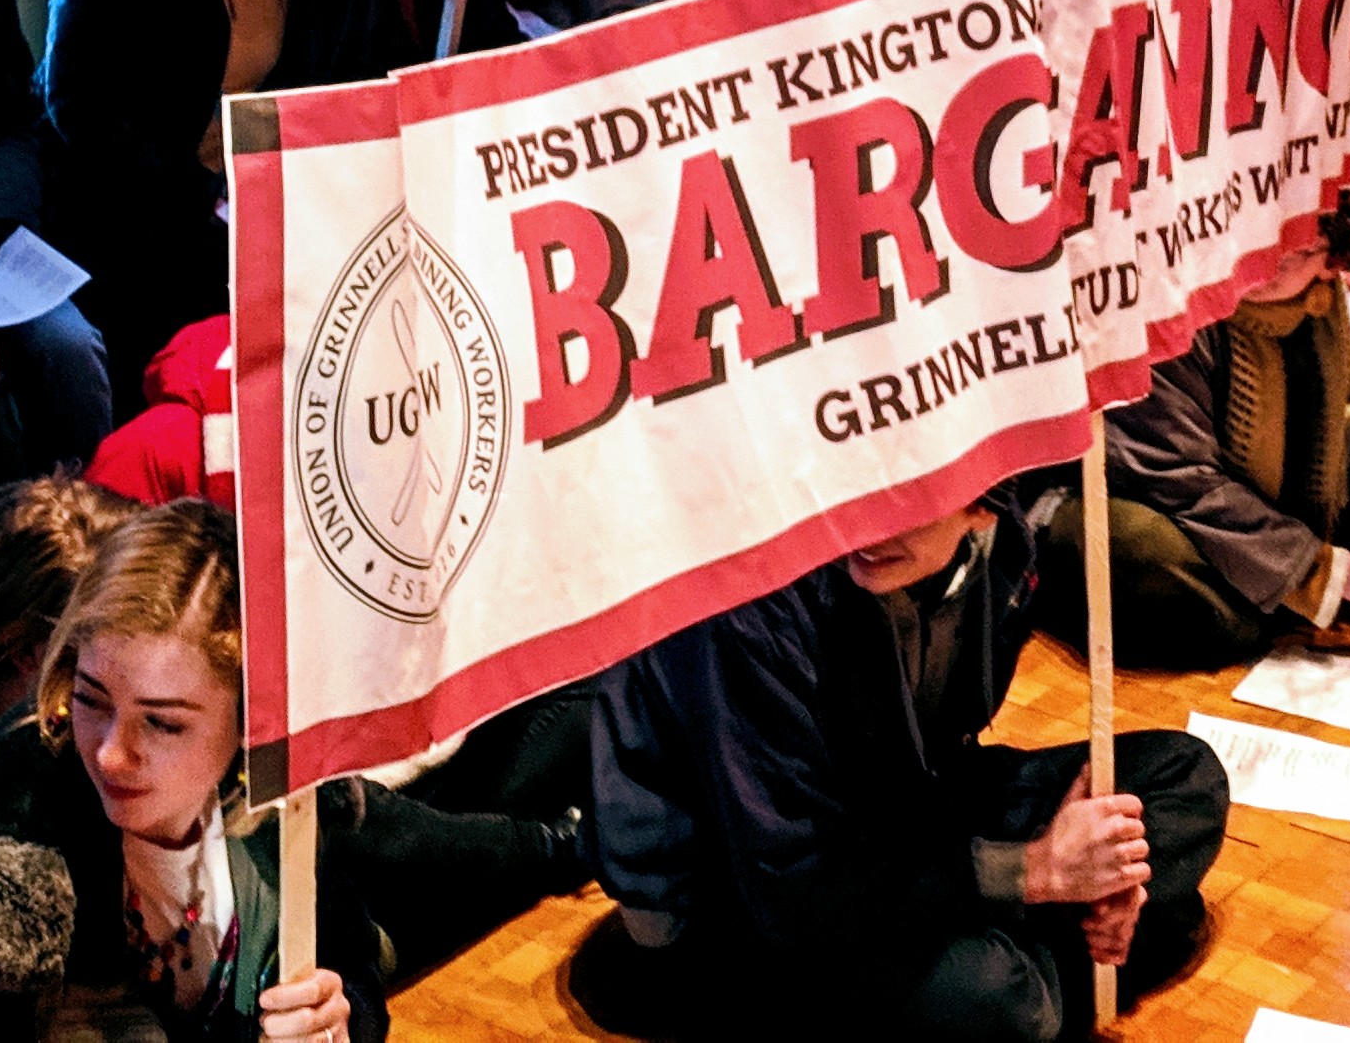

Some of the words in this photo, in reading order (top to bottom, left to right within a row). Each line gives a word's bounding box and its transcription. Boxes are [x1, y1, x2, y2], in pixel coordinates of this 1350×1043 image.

[476, 68, 754, 200] PRESIDENT
[317, 236, 401, 378] GRINNELL
[306, 391, 327, 434] OF
[466, 335, 495, 495] WORKERS
[306, 448, 355, 555] UNION
